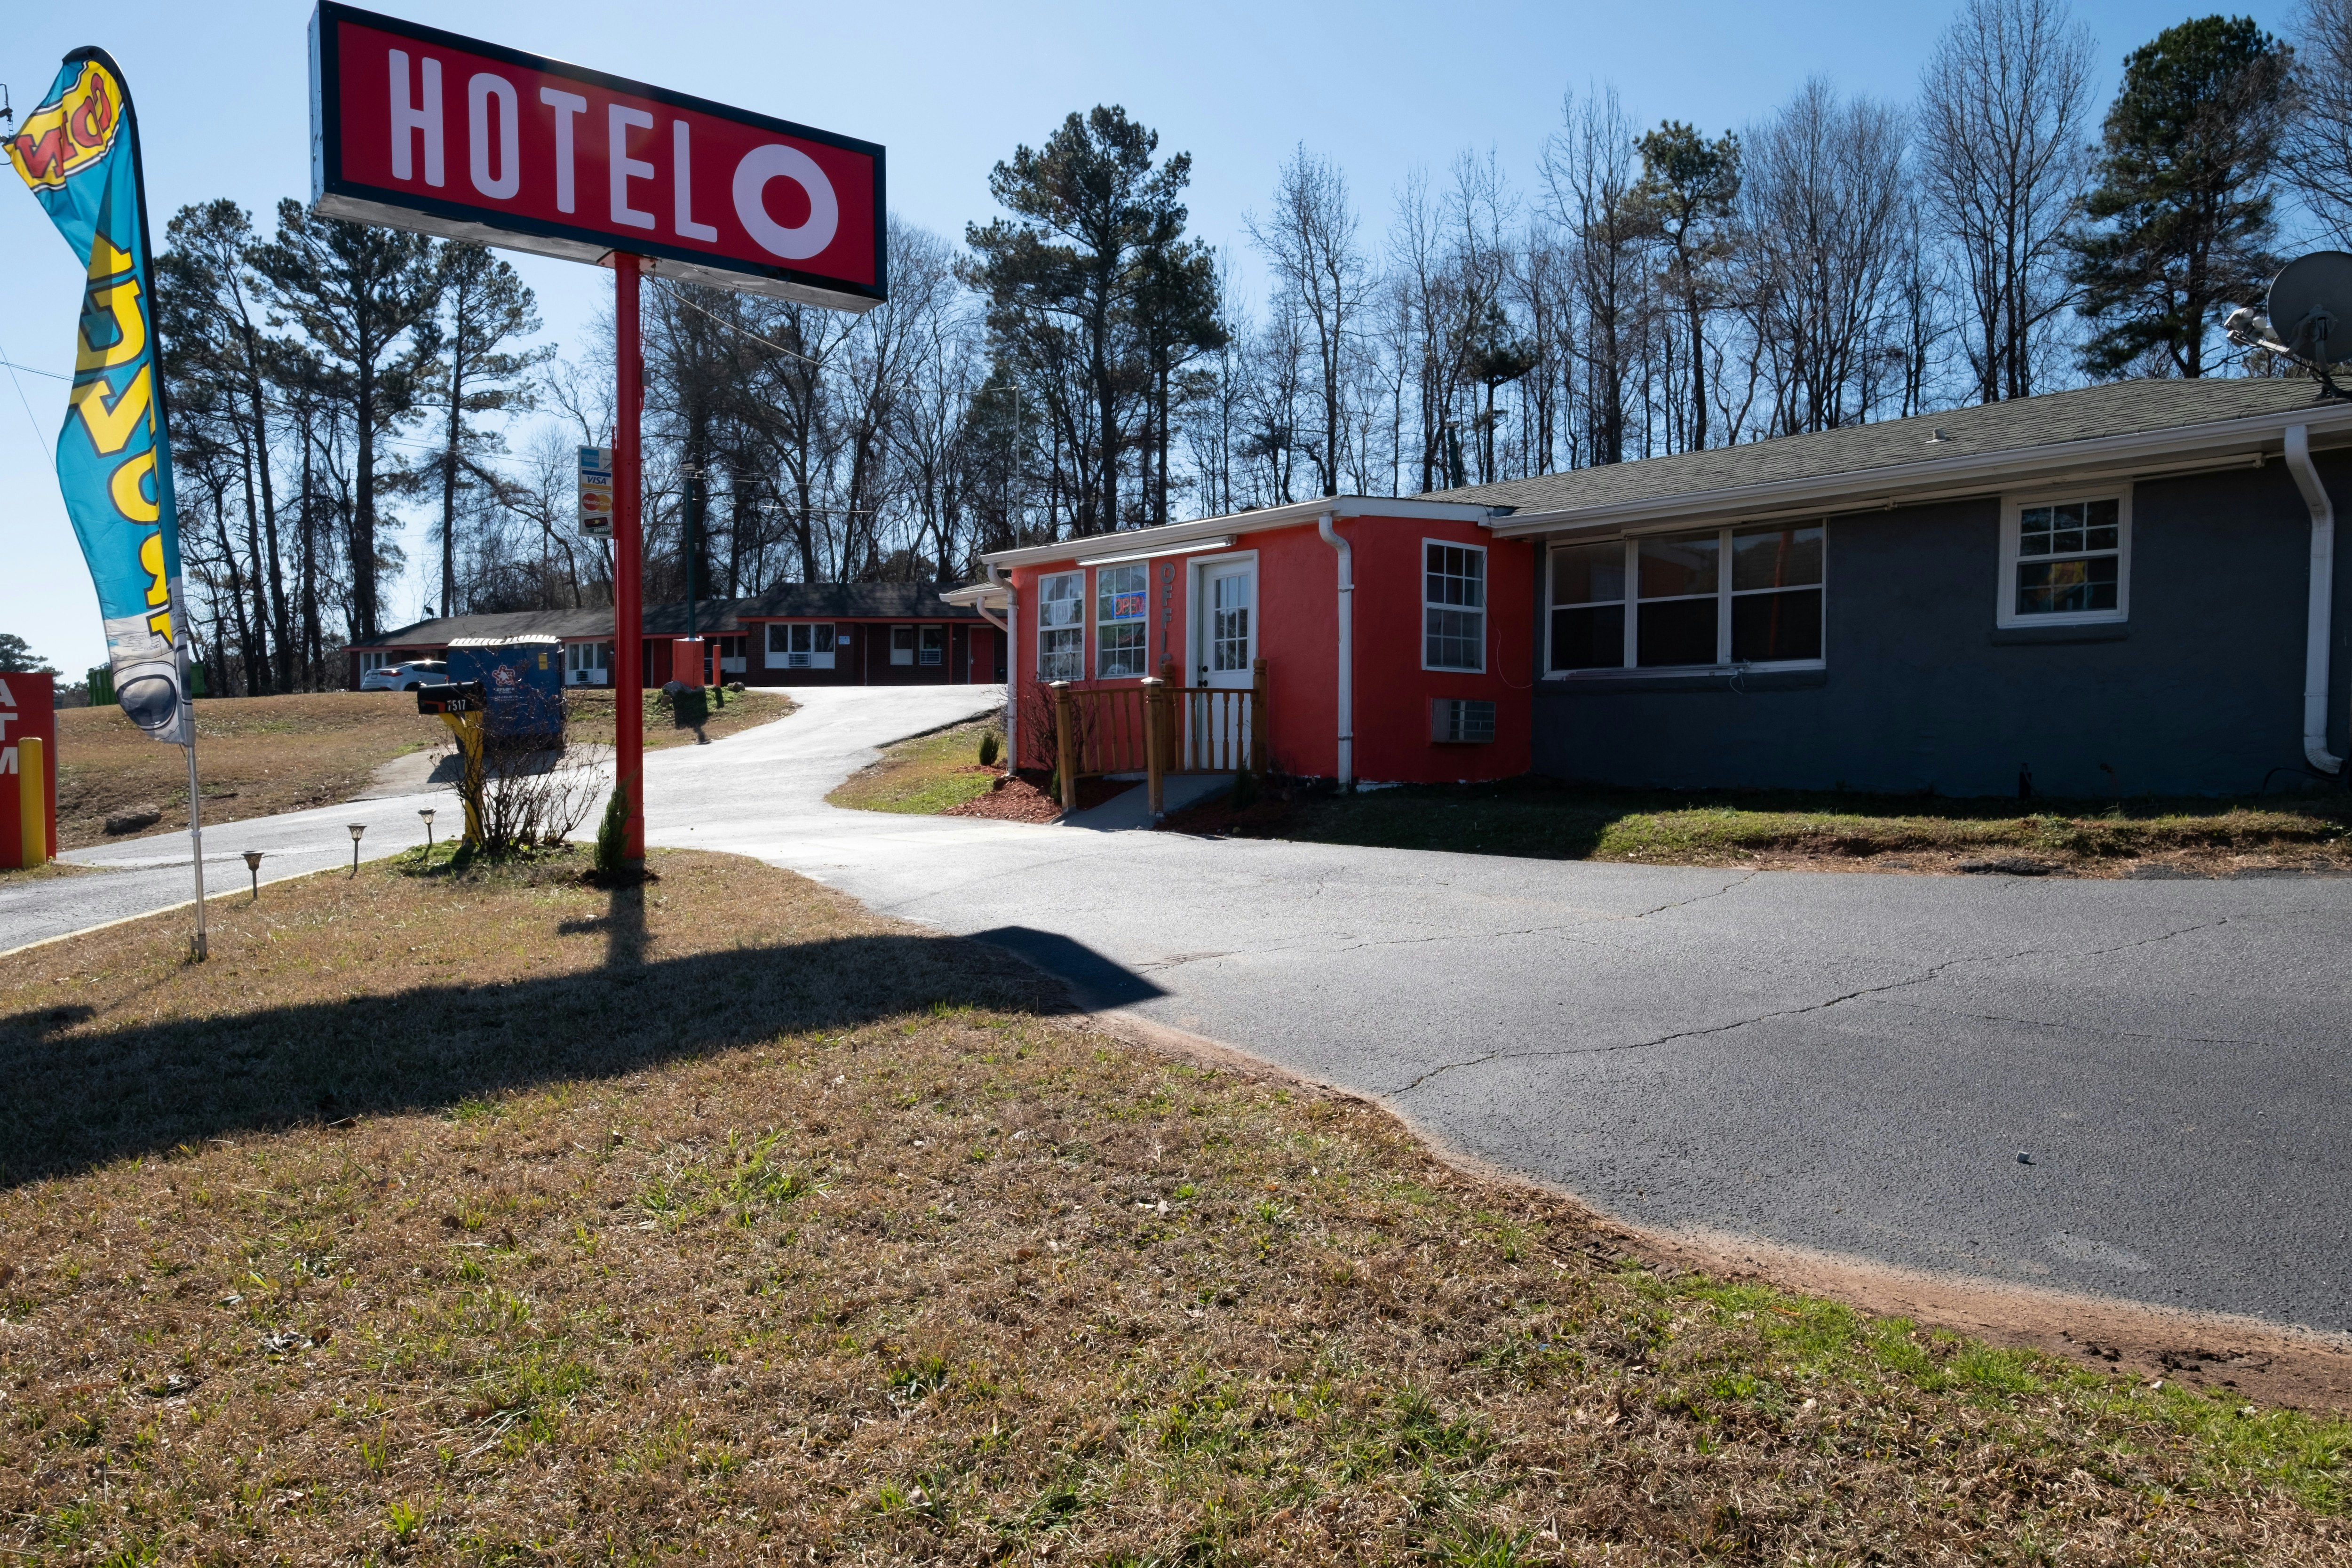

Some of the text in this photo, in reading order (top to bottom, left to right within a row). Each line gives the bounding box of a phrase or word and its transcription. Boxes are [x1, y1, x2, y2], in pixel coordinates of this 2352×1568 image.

[587, 476, 606, 485] VISA
[1115, 597, 1144, 615] OPEN
[1158, 562, 1175, 673] OFFIC
[447, 699, 466, 711] 7517
